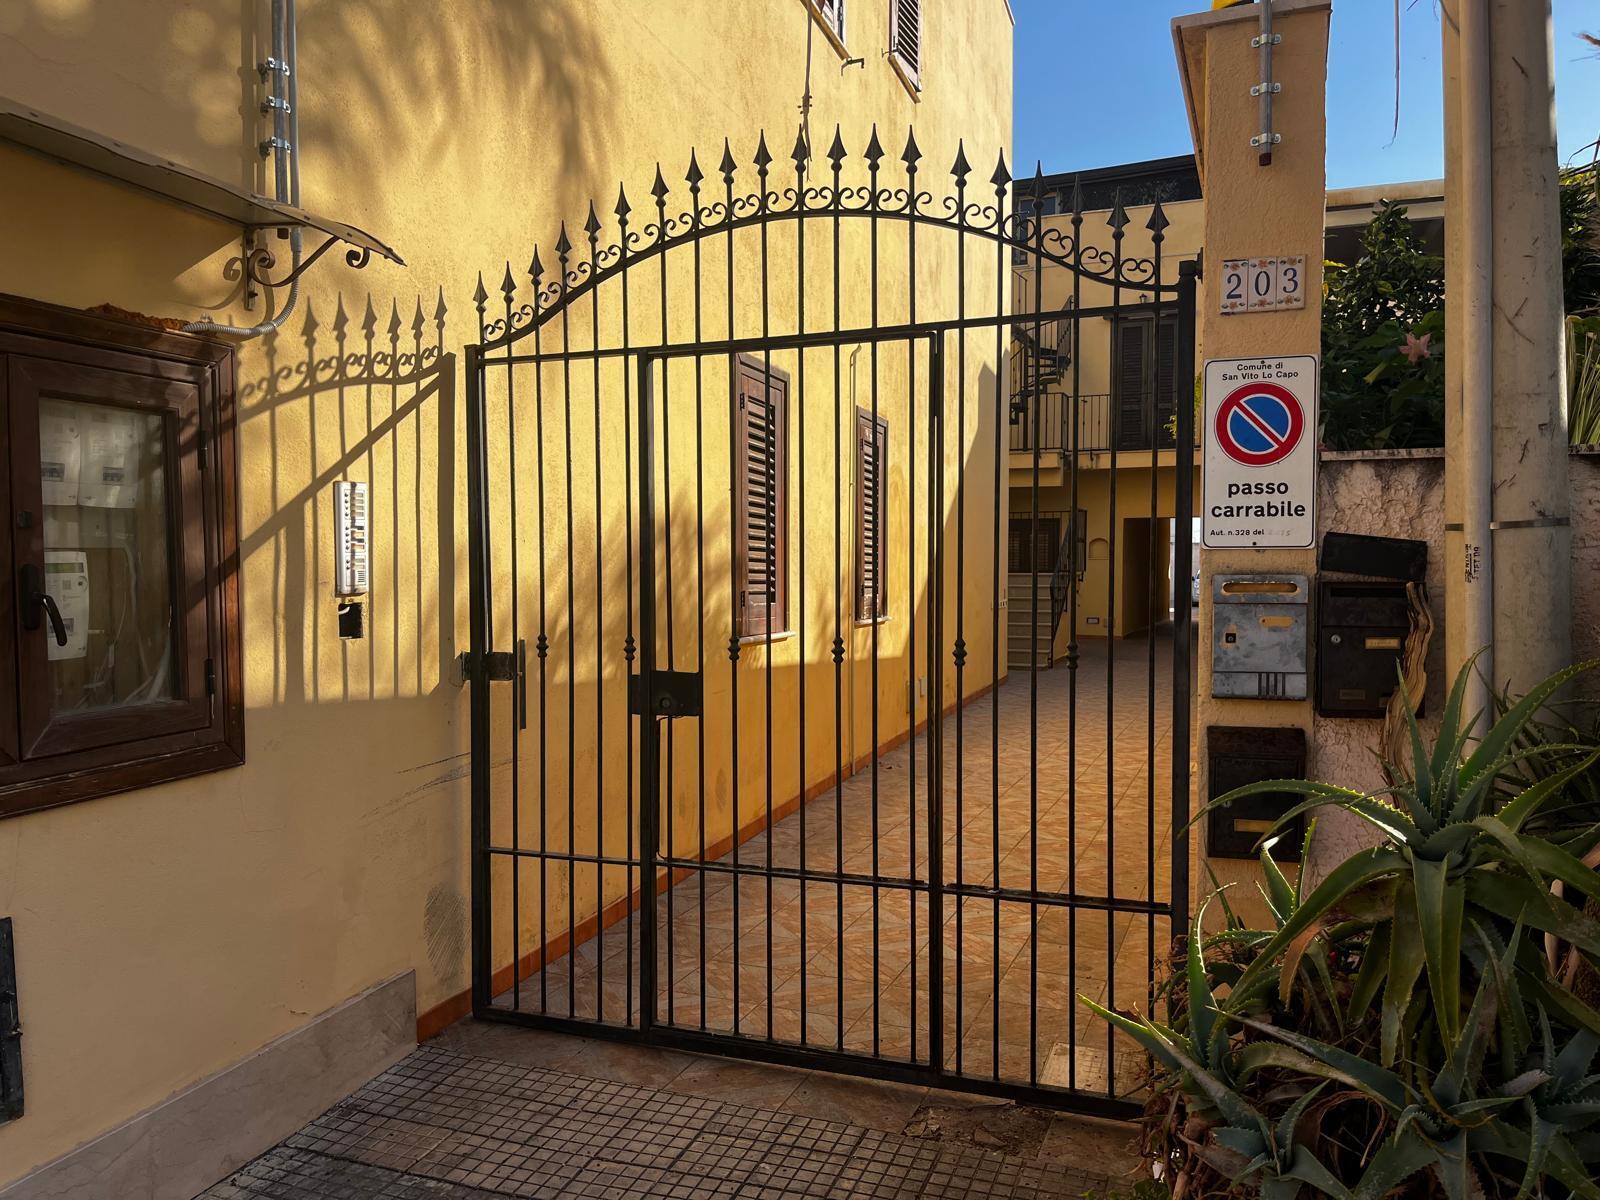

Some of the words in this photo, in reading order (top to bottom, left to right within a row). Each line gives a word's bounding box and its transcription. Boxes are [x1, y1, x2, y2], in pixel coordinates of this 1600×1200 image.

[1226, 267, 1299, 300] 203
[1236, 363, 1272, 371] Comune
[1222, 373, 1238, 381] San
[1241, 372, 1259, 380] Vito
[1262, 371, 1273, 379] Lo
[1275, 370, 1299, 379] Capo
[1228, 482, 1289, 498] passo
[1211, 500, 1306, 518] carrabile
